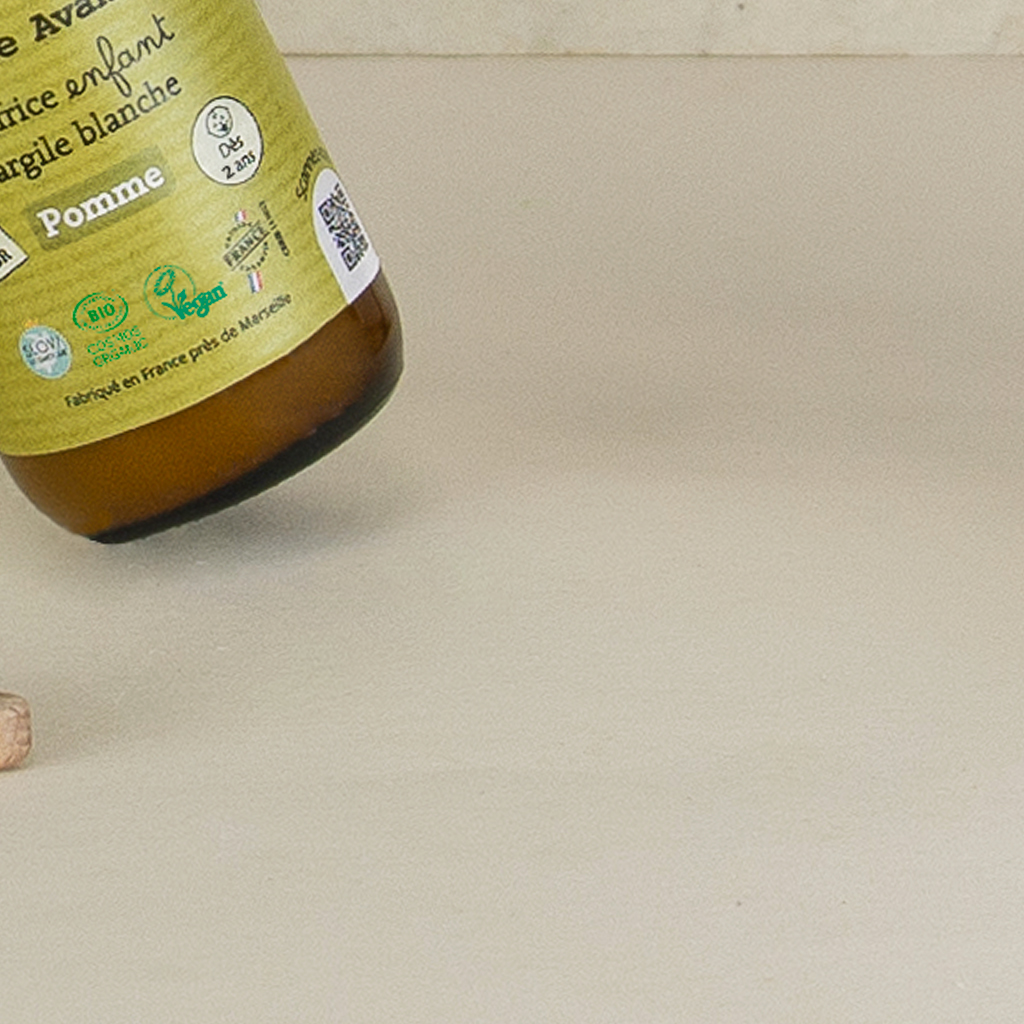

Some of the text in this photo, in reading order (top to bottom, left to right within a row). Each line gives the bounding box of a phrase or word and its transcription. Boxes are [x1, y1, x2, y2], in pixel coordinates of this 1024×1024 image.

[65, 13, 175, 100] enfant
[71, 76, 182, 147] blanche
[218, 135, 245, 159] Dès
[221, 149, 257, 180] 2 ans
[36, 166, 166, 238] Pomme
[224, 224, 267, 267] FRANCE
[87, 302, 116, 323] BIO
[162, 282, 227, 320] Vegan
[64, 293, 292, 409] Fabriqué en France près de Marseille
[87, 325, 142, 355] COSMOS
[92, 337, 149, 368] ORGANIC
